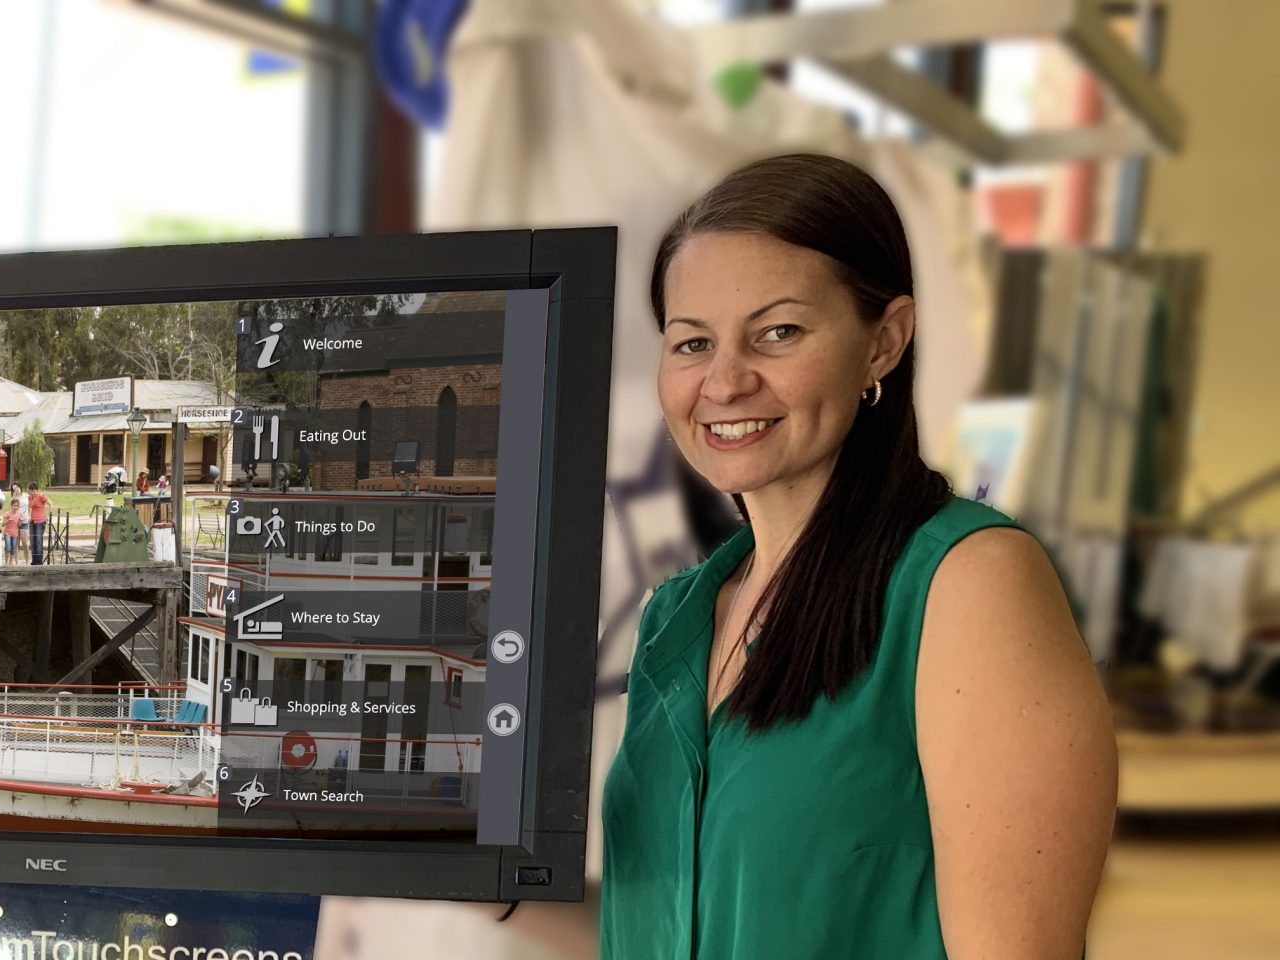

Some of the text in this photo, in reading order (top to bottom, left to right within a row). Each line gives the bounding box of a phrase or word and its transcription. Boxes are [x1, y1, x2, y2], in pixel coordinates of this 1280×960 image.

[303, 337, 363, 351] Welcome
[233, 409, 244, 423] 2
[299, 429, 367, 444] Eating Out
[230, 500, 240, 514] 3
[295, 520, 376, 535] Things to Do
[226, 589, 236, 603] 4
[291, 612, 380, 627] Where to Stay
[223, 679, 232, 692] 5
[287, 701, 416, 716] Shopping & Services
[219, 767, 229, 780] 6
[283, 790, 364, 802] Town Search
[25, 857, 67, 873] NEC
